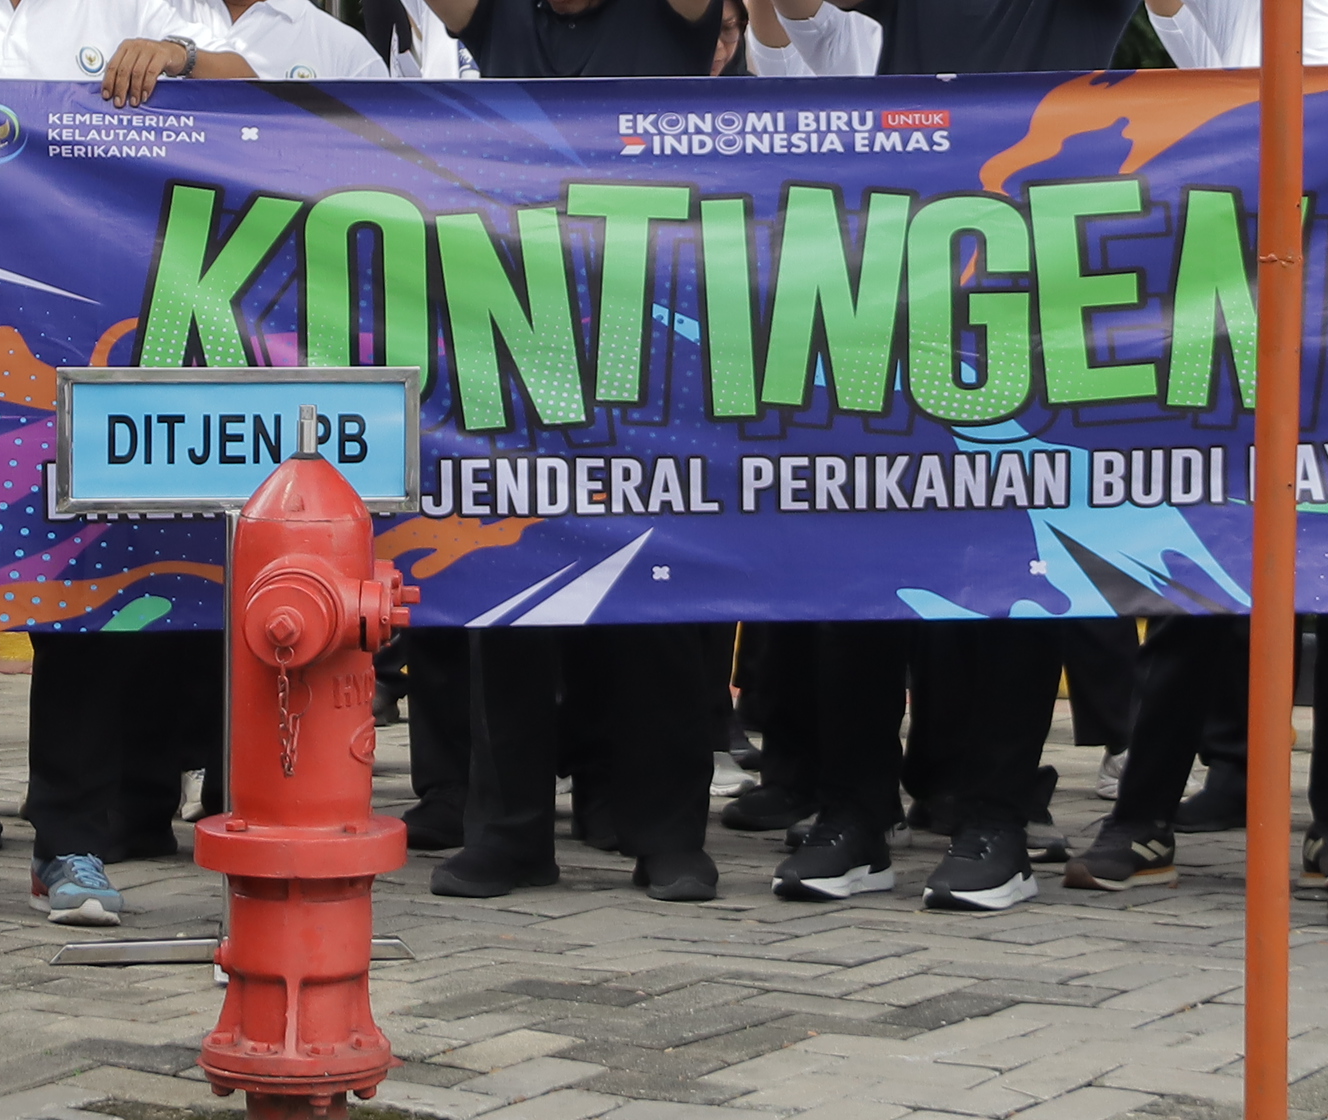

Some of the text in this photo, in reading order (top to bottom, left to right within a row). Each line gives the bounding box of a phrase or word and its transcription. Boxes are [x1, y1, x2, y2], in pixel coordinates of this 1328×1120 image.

[48, 113, 195, 128] KEMENTERIAN
[618, 110, 945, 134] EKONOMI BIRU UNTUK
[48, 128, 206, 143] KELAUTAN DAN
[653, 130, 951, 155] INDONESIA EMAS
[48, 145, 167, 158] PERIKANAN
[136, 179, 1312, 431] KONTINGEN
[107, 414, 282, 465] DITJEN
[422, 455, 719, 516] JENDERAL
[742, 451, 1067, 511] PERIKANAN
[1092, 446, 1223, 505] BUDI
